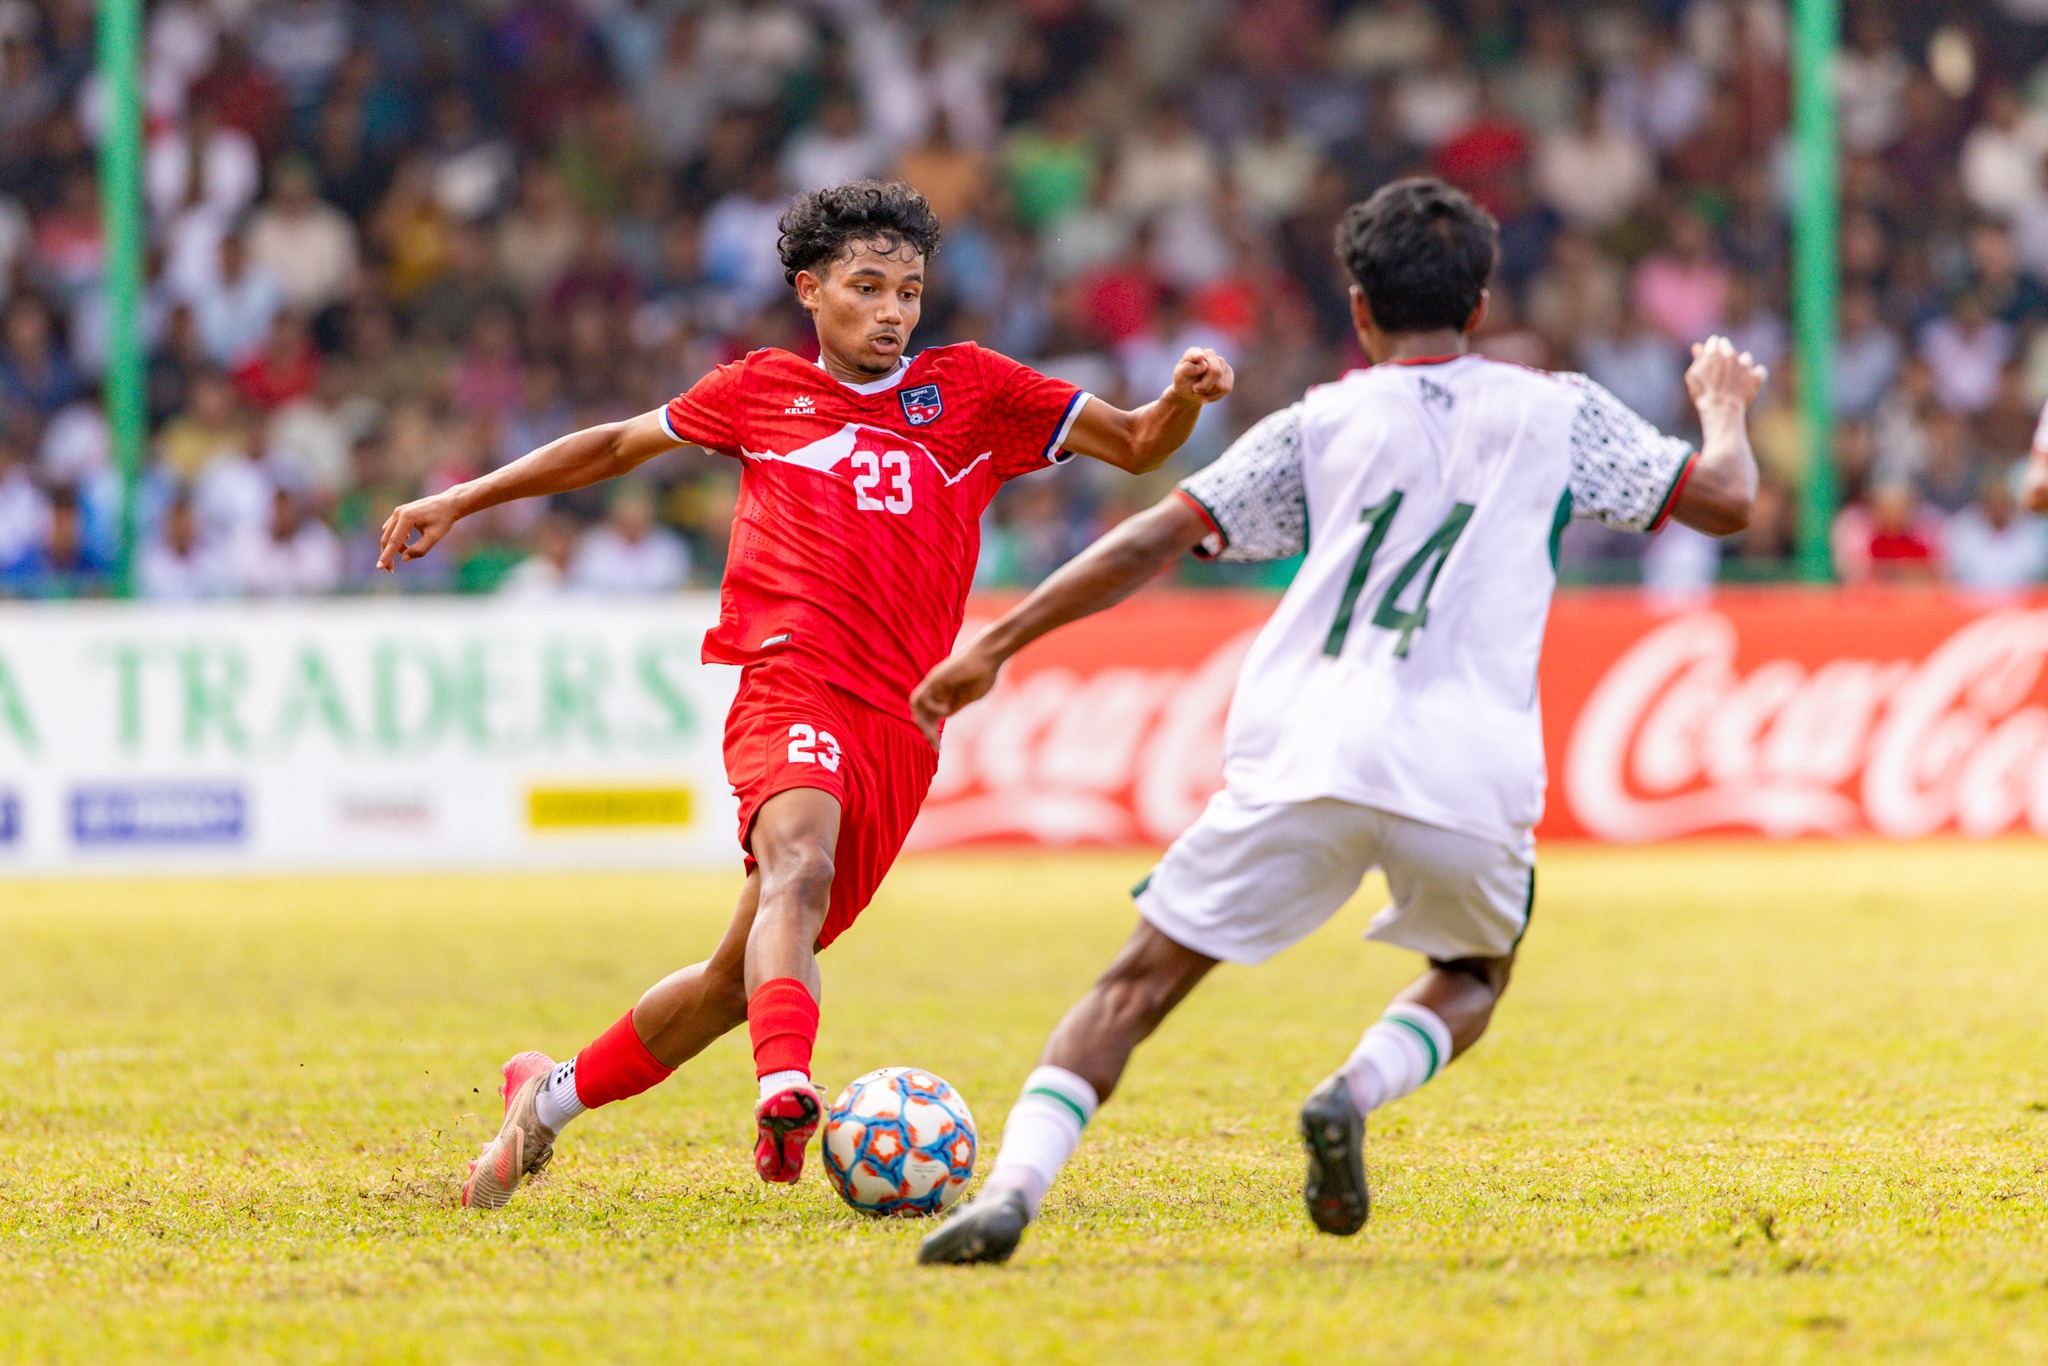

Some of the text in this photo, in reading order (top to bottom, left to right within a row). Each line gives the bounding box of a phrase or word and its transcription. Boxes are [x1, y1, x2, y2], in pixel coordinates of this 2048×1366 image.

[784, 407, 816, 415] KELME
[850, 450, 913, 515] 23
[1322, 489, 1476, 660] 14
[84, 636, 700, 756] TRADERS
[1563, 604, 2048, 843] Coca-Co
[787, 723, 843, 773] 23
